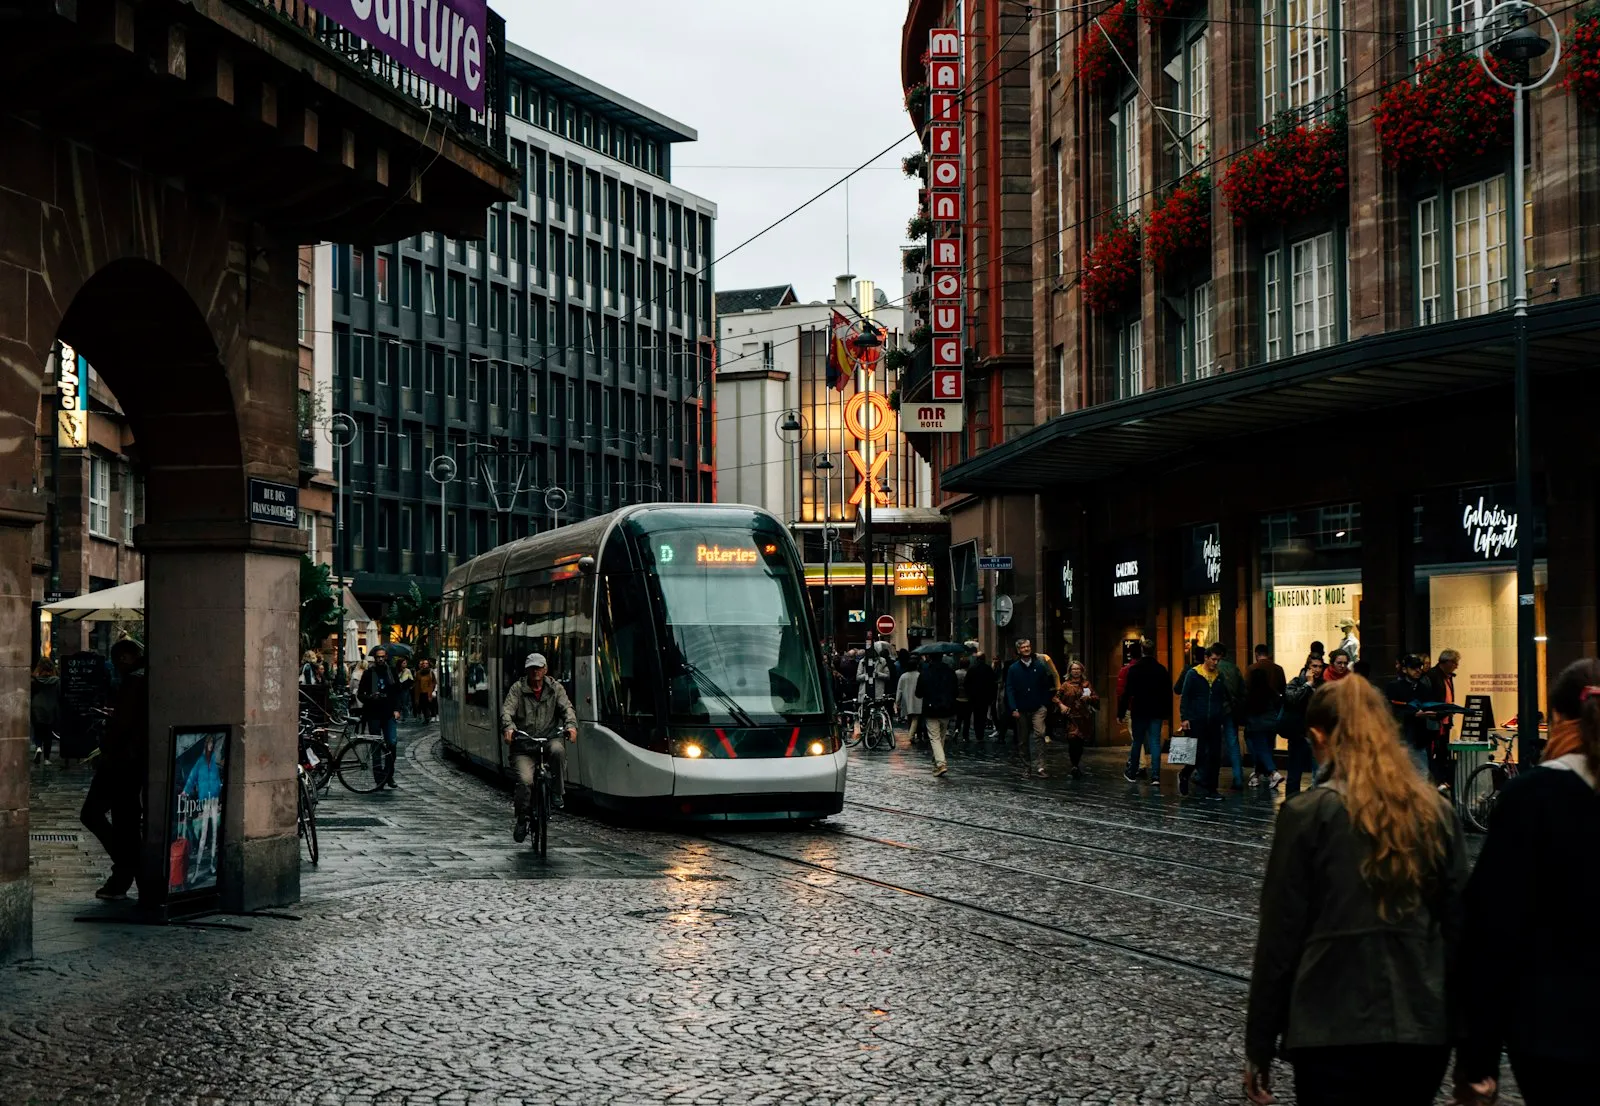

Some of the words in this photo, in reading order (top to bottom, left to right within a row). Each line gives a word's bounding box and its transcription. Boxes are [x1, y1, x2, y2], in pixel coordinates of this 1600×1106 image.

[932, 33, 959, 217] MAISON
[937, 243, 958, 395] ROUGE
[58, 339, 79, 410] odyss
[918, 407, 945, 420] MR
[263, 488, 274, 500] RUE
[275, 490, 286, 502] DES
[1463, 496, 1507, 536] Galeries
[661, 545, 673, 562] D
[697, 544, 758, 562] Poteries
[1115, 560, 1138, 578] GALERIES
[1113, 580, 1140, 598] LAFAYETTE
[1267, 589, 1310, 609] CHANGEONS
[1312, 588, 1322, 606] DE
[1324, 586, 1346, 605] MODE
